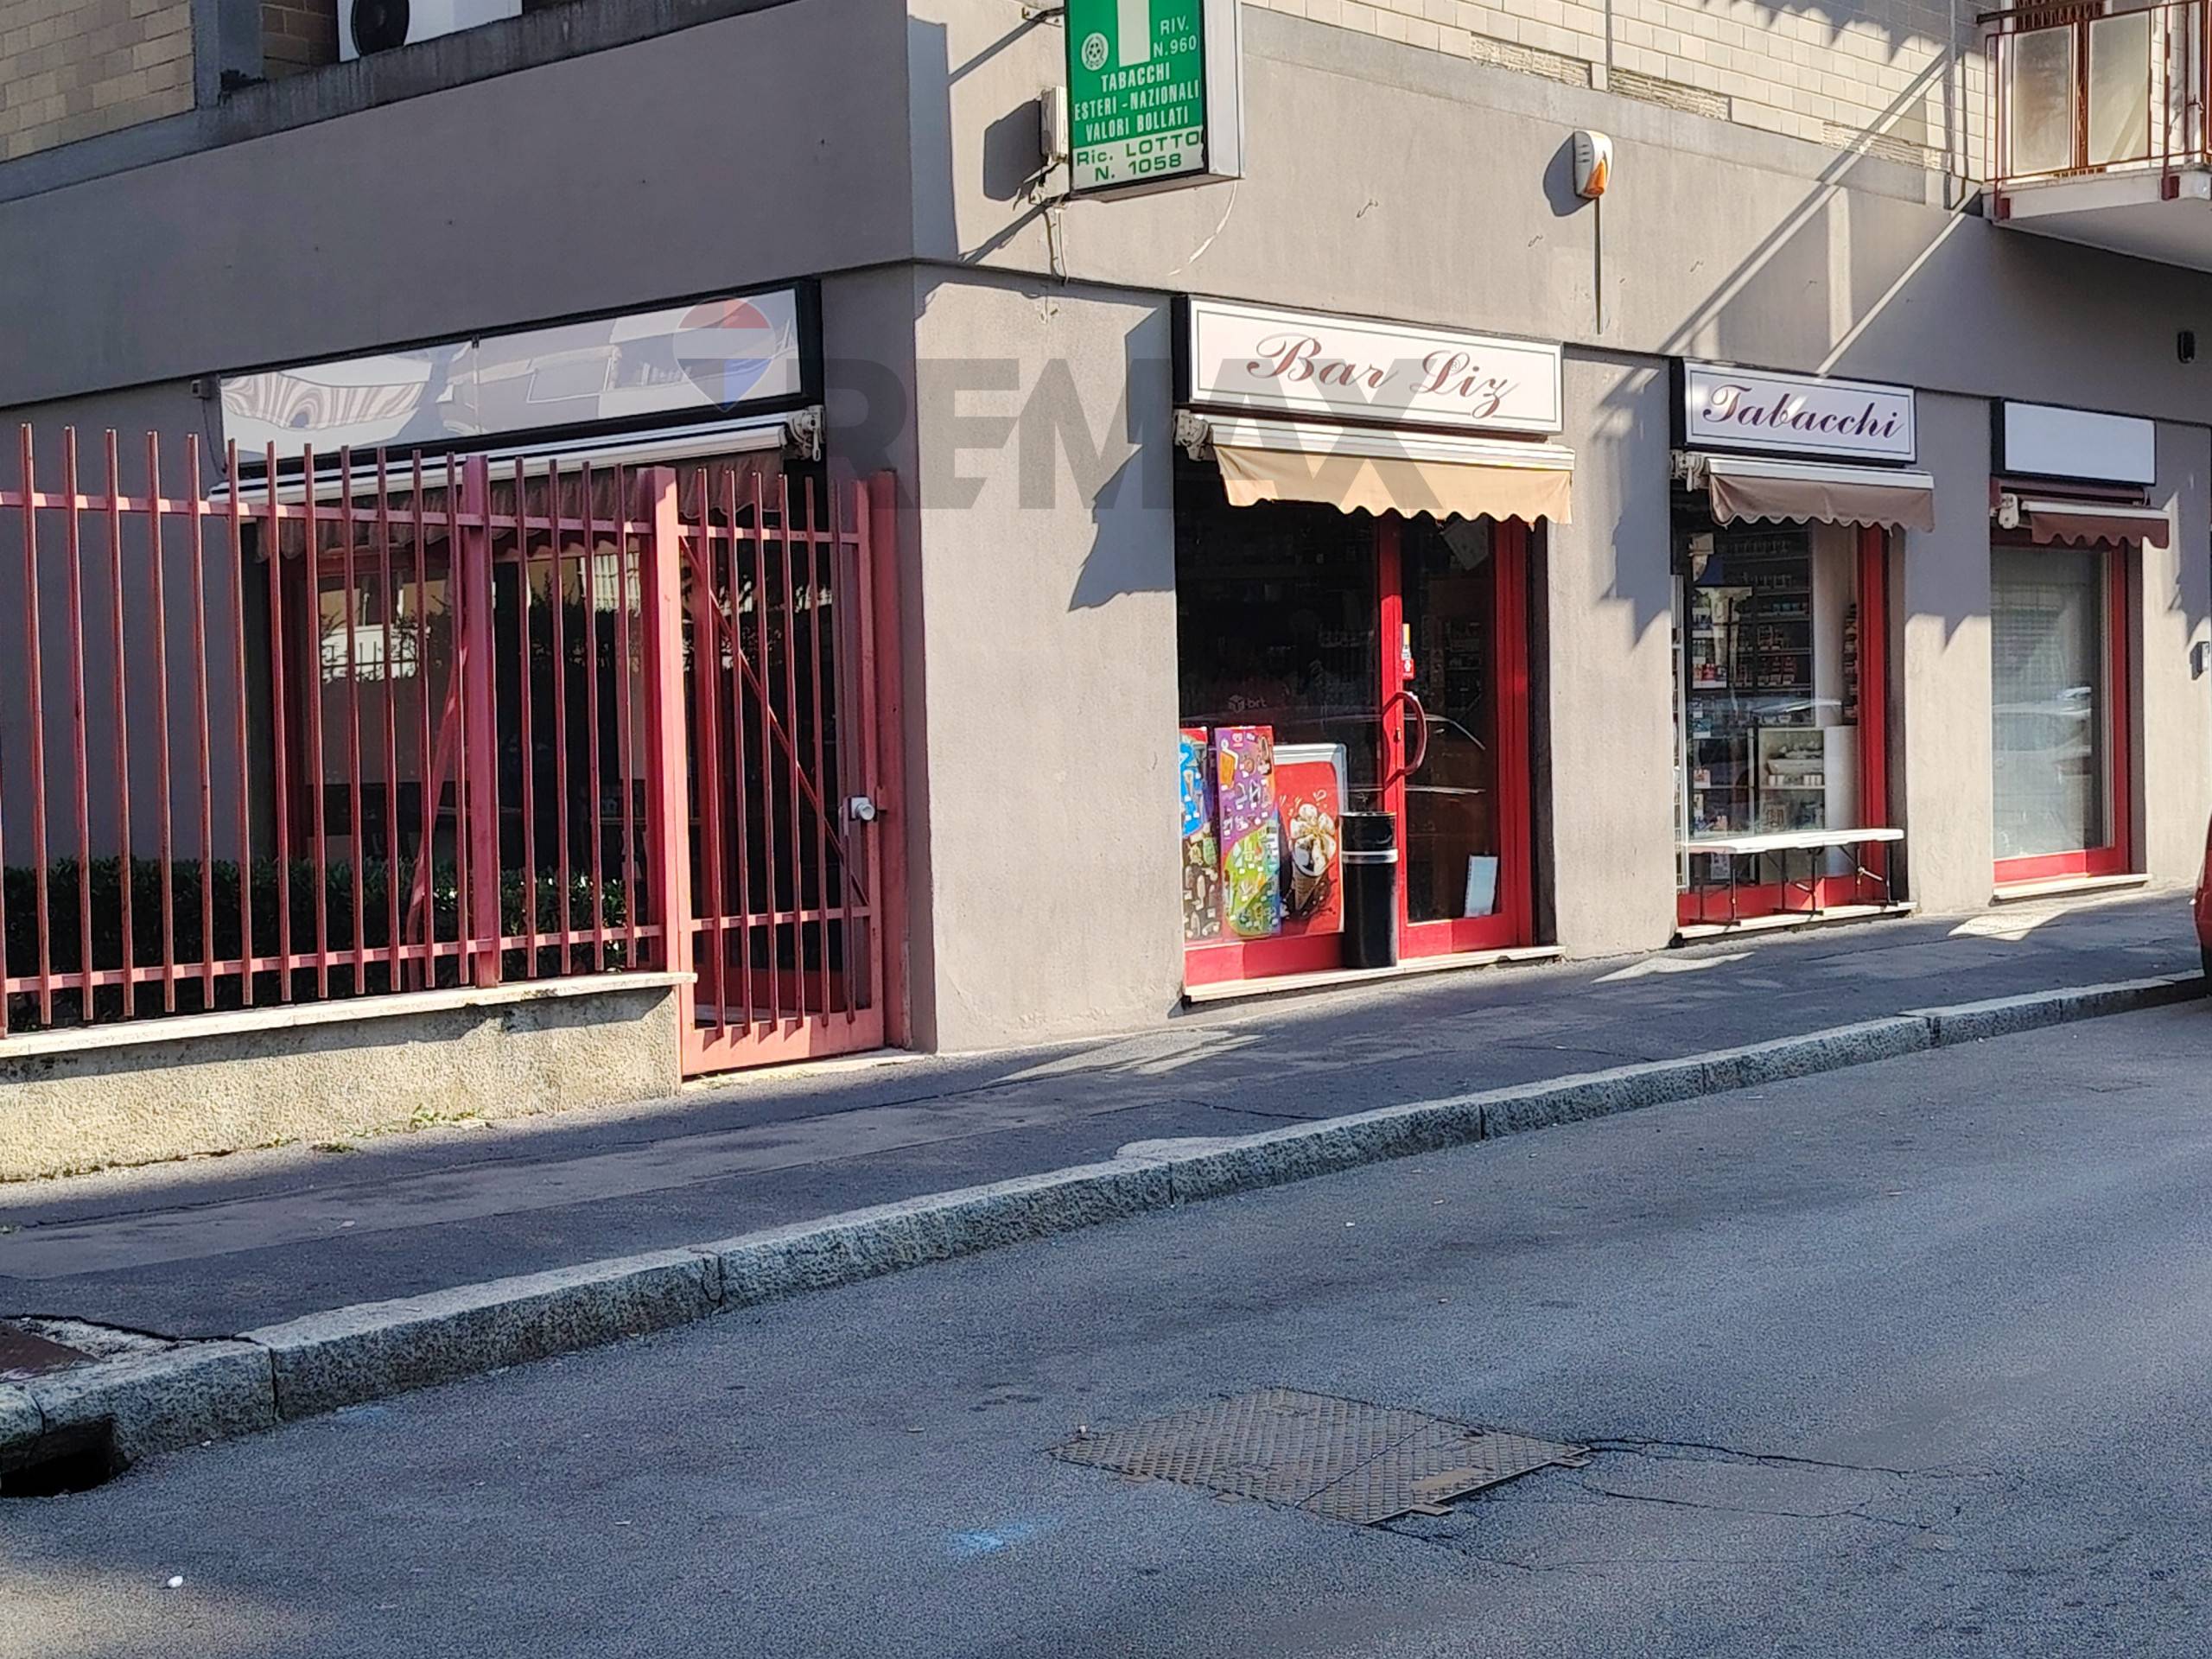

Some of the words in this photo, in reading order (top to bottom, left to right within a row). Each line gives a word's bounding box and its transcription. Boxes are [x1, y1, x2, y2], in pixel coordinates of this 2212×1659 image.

[1160, 16, 1189, 35] RIV.
[1153, 35, 1198, 58] N.960
[1101, 62, 1171, 92] TABACCHI
[1074, 96, 1117, 122] ESTERI
[1130, 79, 1199, 111] NAZIONALI
[1085, 117, 1130, 143] VALORI
[1136, 105, 1189, 133] BOLLATI
[1126, 130, 1200, 158] LOTTO
[1095, 165, 1116, 181] N.
[1128, 153, 1182, 175] 1058
[1247, 332, 1399, 391] Bar
[1409, 349, 1519, 419] Liz
[1702, 384, 1904, 439] Tabacchi
